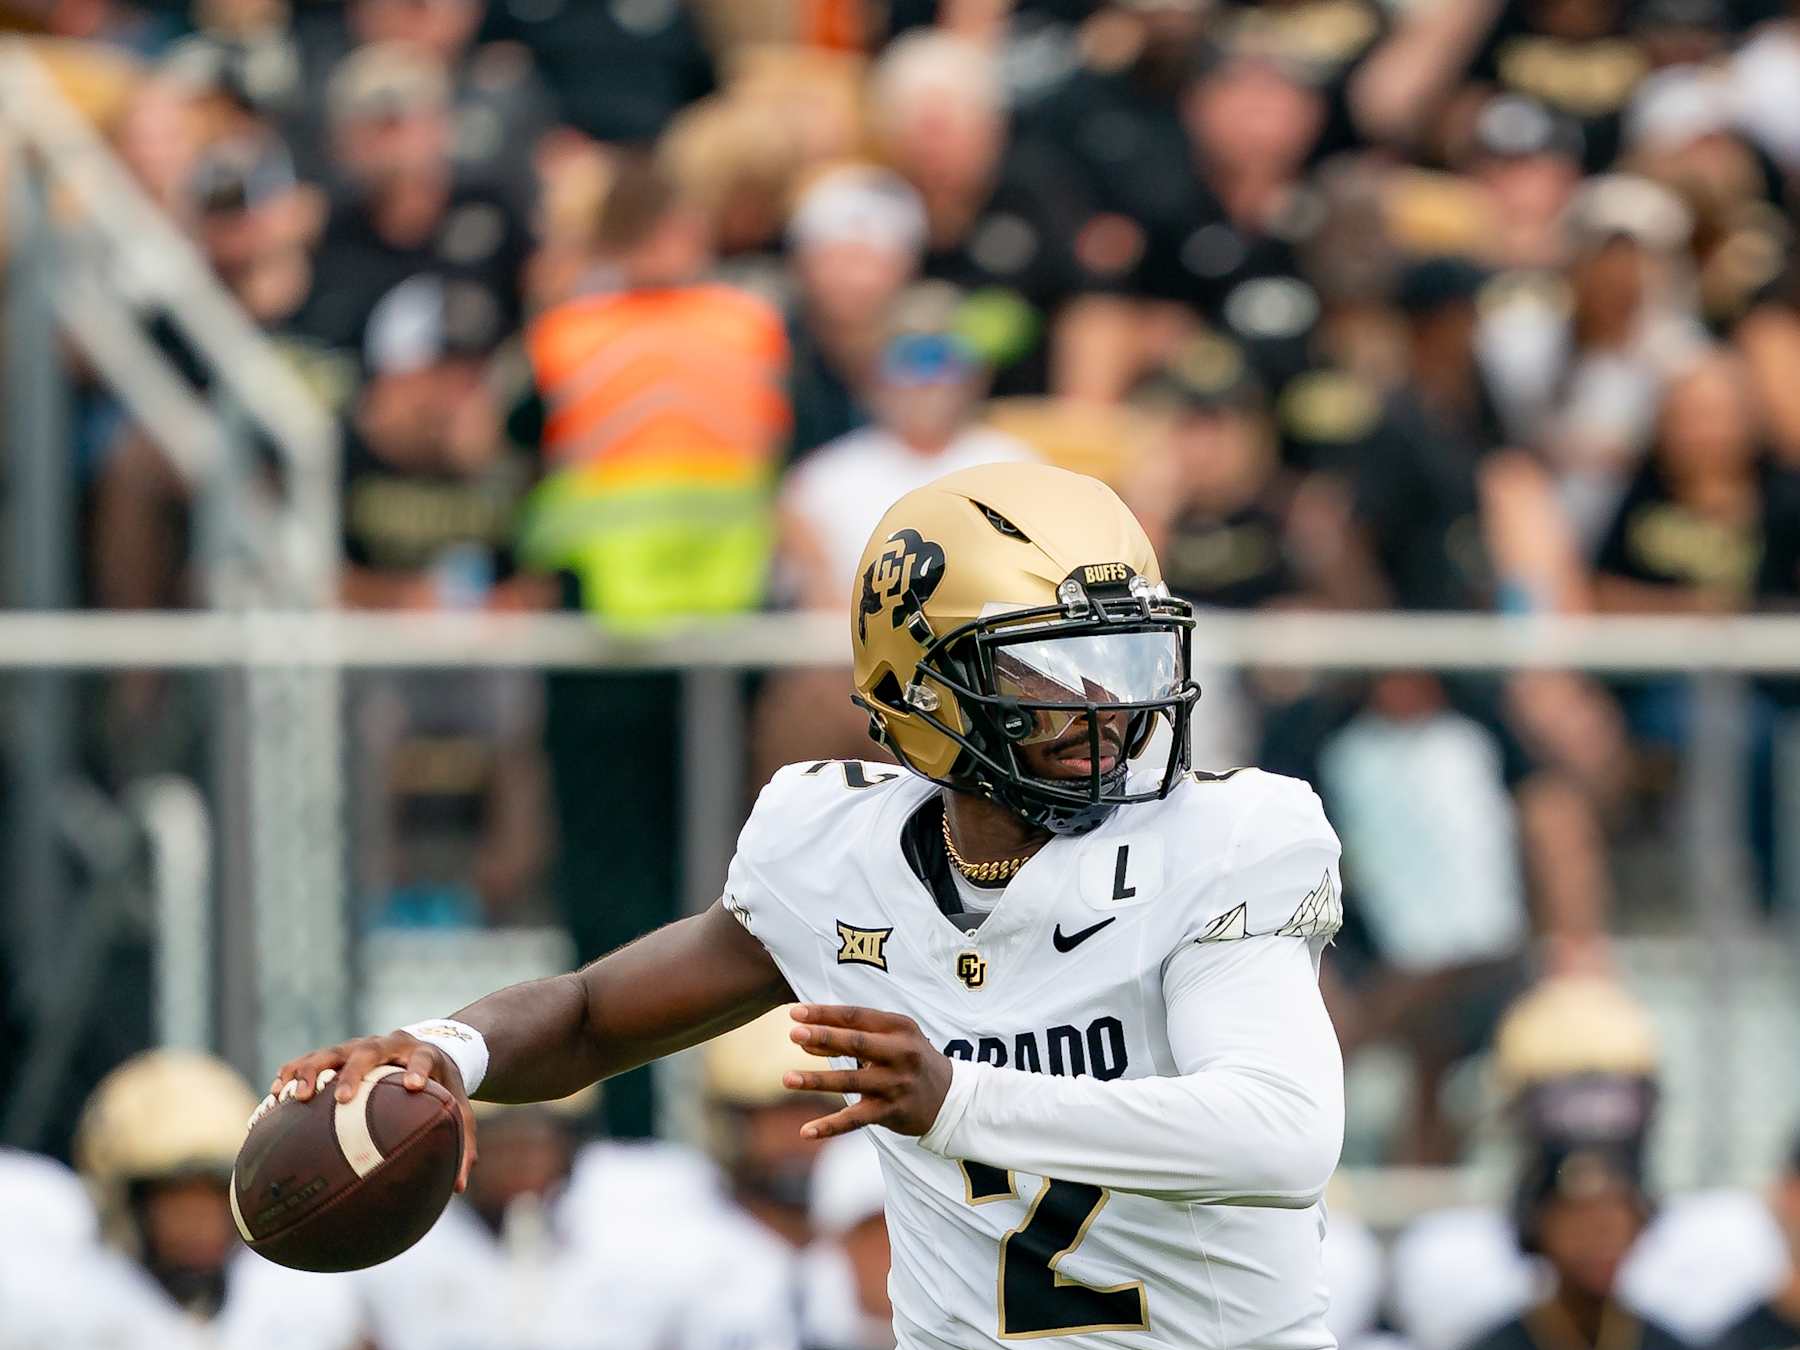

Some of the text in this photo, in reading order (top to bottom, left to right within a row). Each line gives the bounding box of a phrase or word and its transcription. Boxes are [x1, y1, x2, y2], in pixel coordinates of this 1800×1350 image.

[1084, 563, 1127, 584] BUFFS
[1112, 844, 1136, 900] L
[957, 950, 988, 990] CU
[957, 1157, 1151, 1340] 2
